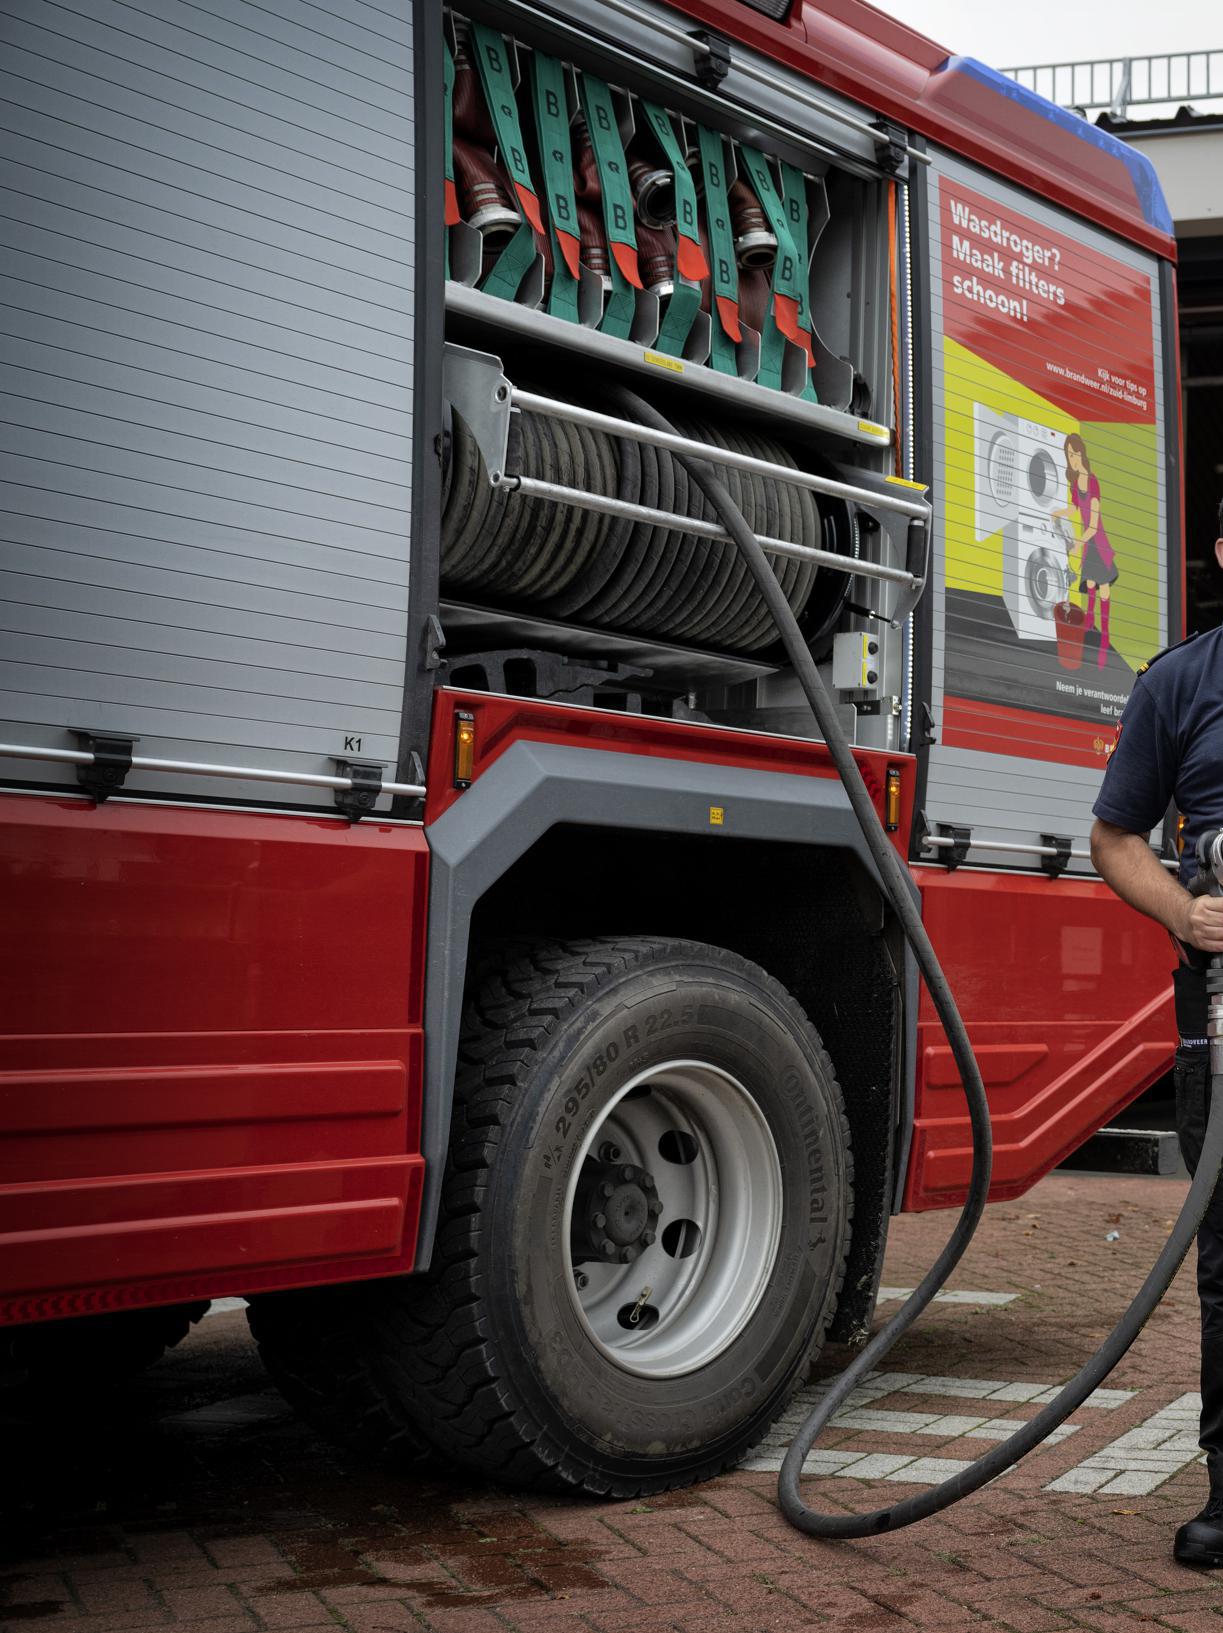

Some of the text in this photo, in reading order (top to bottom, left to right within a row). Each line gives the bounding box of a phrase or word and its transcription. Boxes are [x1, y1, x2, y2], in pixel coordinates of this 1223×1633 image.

[485, 44, 502, 73] B
[545, 89, 560, 118] B
[595, 104, 611, 131] B
[654, 113, 670, 136] B
[510, 146, 525, 173] B
[709, 161, 720, 188] B
[756, 169, 770, 192] B
[555, 193, 571, 221] B
[613, 203, 627, 230] B
[683, 199, 694, 226] B
[790, 198, 801, 222] B
[950, 199, 1061, 272] Wasdroger?
[719, 258, 731, 284] B
[781, 256, 793, 281] B
[952, 234, 1066, 306] Maak filters
[952, 274, 1028, 323] schoon!
[1046, 361, 1147, 411] www.brandweer.nl/zuid-limburg
[1097, 367, 1147, 398] Kijk voor tips op
[1055, 680, 1076, 694] Neem
[1076, 683, 1083, 697] je
[1100, 703, 1113, 716] leef
[343, 736, 362, 752] K1
[555, 1042, 620, 1130] 295/80
[623, 1024, 641, 1050] R
[644, 1004, 695, 1038] 22.5
